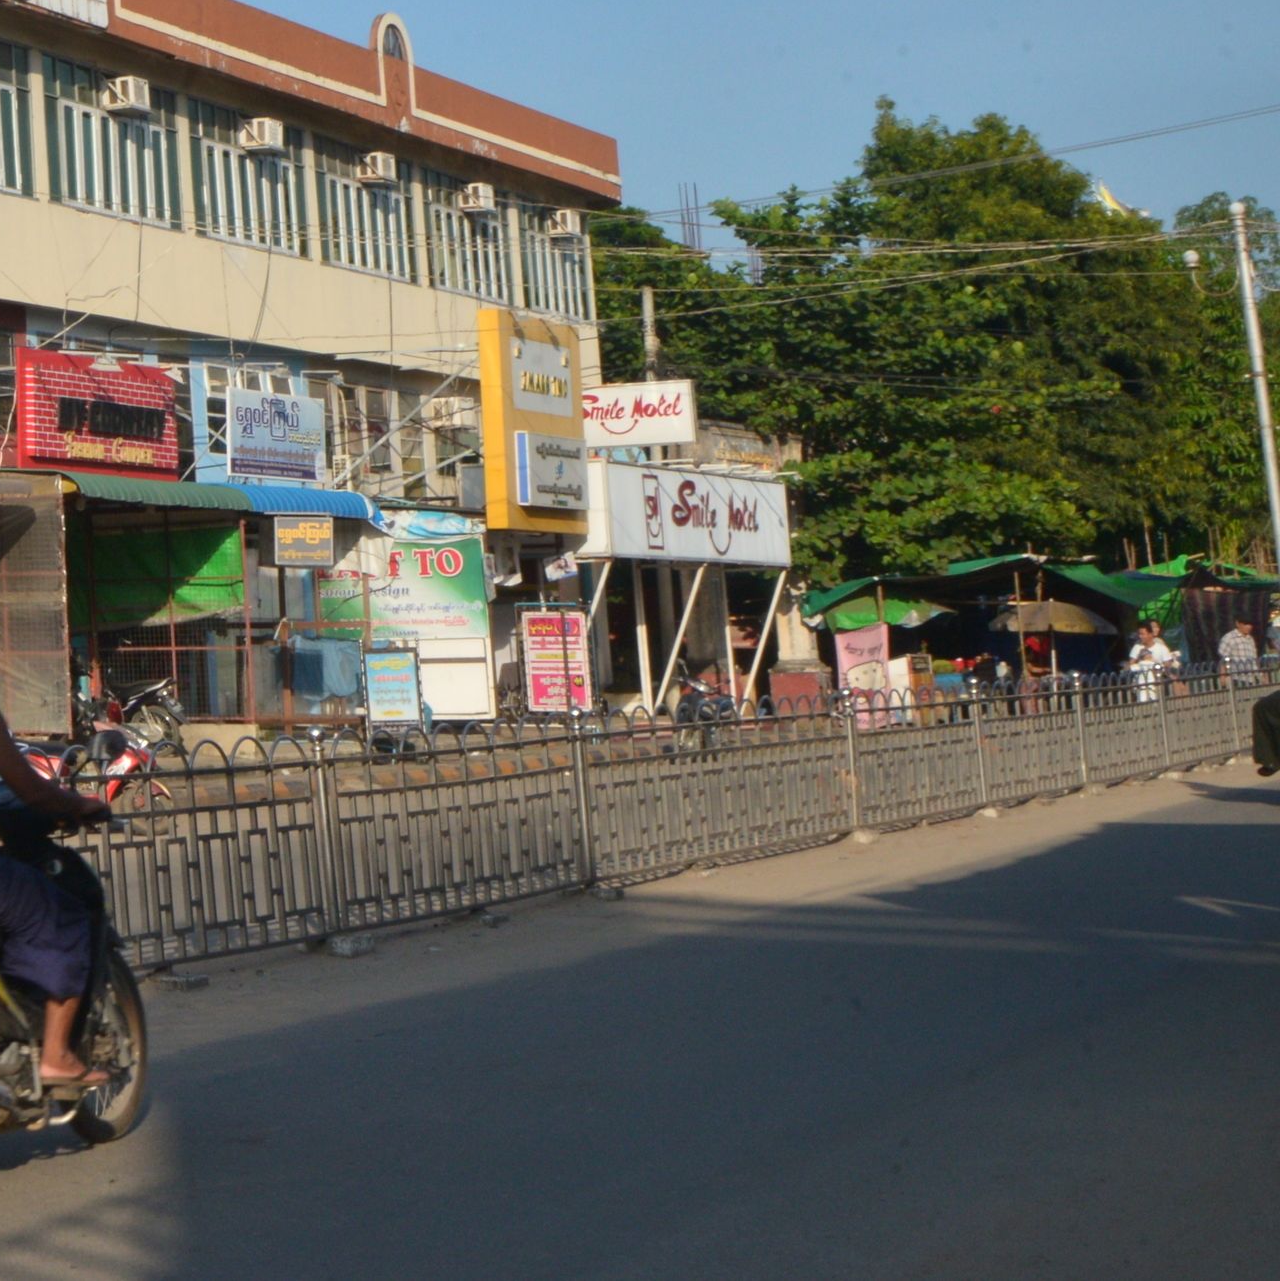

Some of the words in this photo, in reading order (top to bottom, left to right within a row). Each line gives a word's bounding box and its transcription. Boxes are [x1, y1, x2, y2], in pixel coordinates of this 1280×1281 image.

[581, 393, 626, 421] Smile
[630, 391, 685, 419] Motel
[670, 478, 719, 531] Smile
[726, 492, 760, 533] Motel
[413, 547, 464, 578] TO
